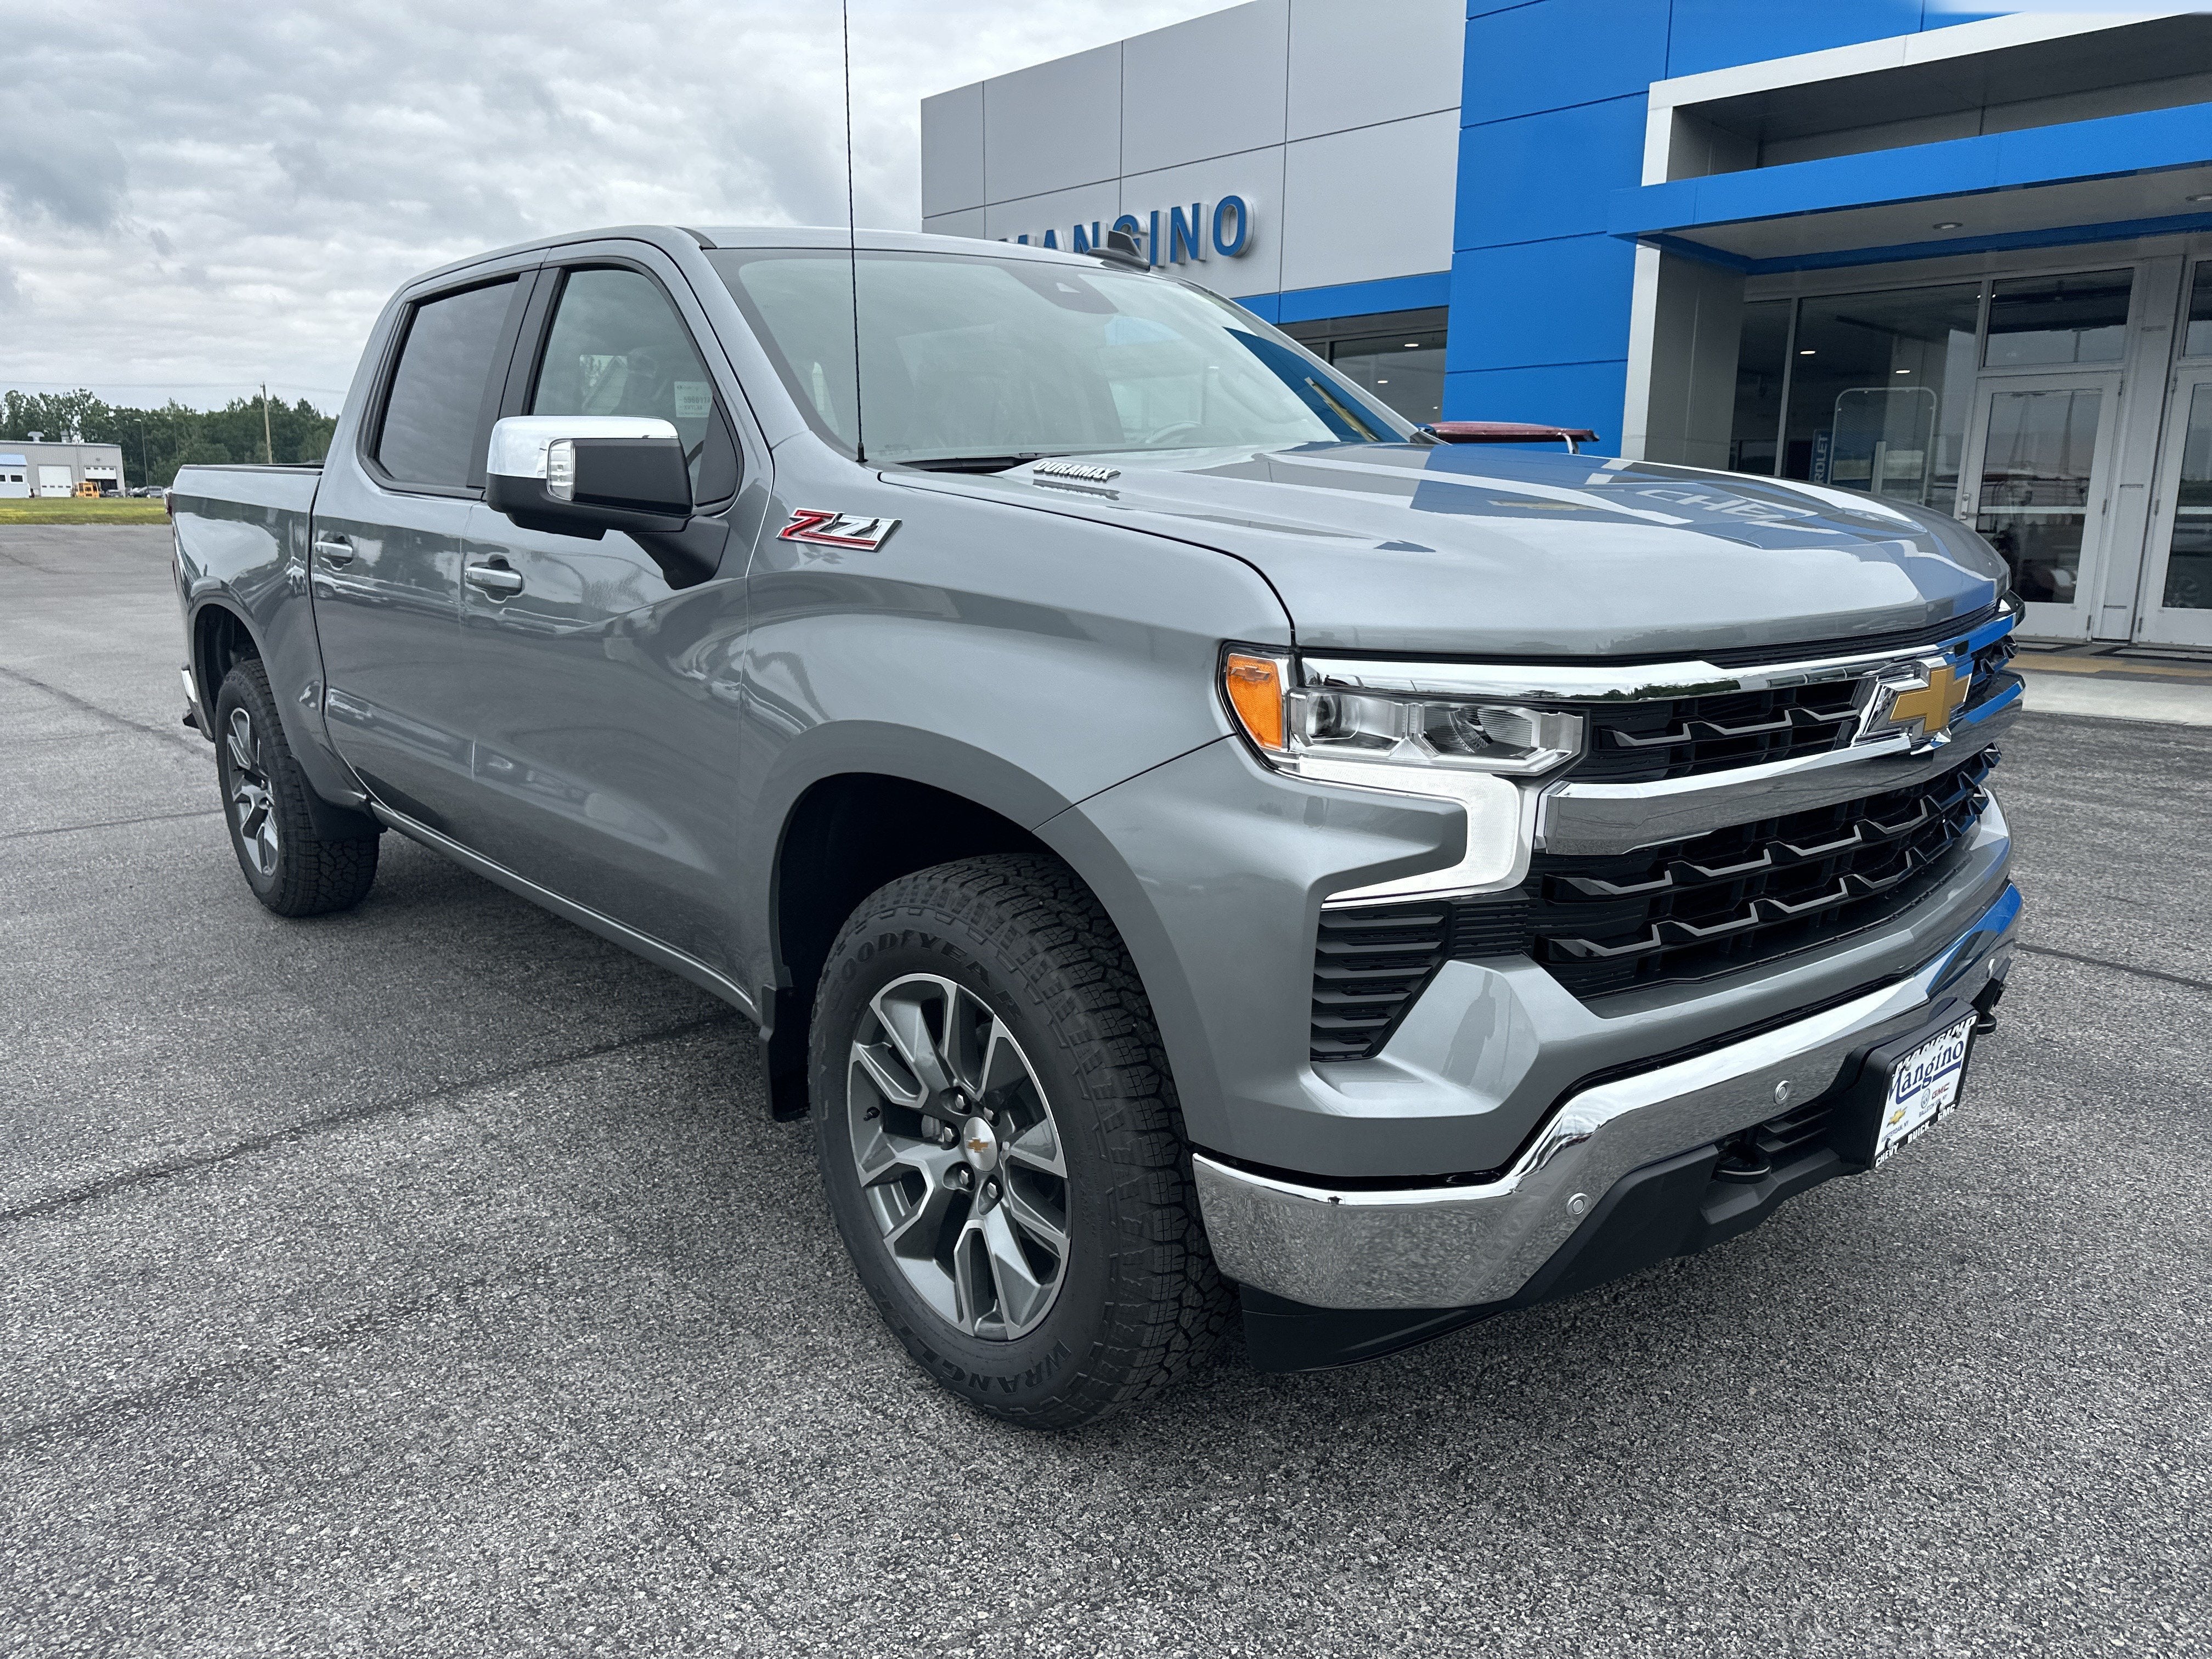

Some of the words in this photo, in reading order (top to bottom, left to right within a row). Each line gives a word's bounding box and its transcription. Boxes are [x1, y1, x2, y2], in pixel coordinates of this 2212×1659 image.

[998, 195, 1251, 267] NGINO
[1032, 460, 1117, 482] DURAMAX
[776, 507, 902, 552] Z71
[1888, 1040, 1963, 1104] Mangino
[1931, 1082, 1950, 1100] GMC
[1937, 1103, 1956, 1121] GMC
[1906, 1120, 1931, 1144] BUICK
[1875, 1142, 1899, 1167] CHEVY
